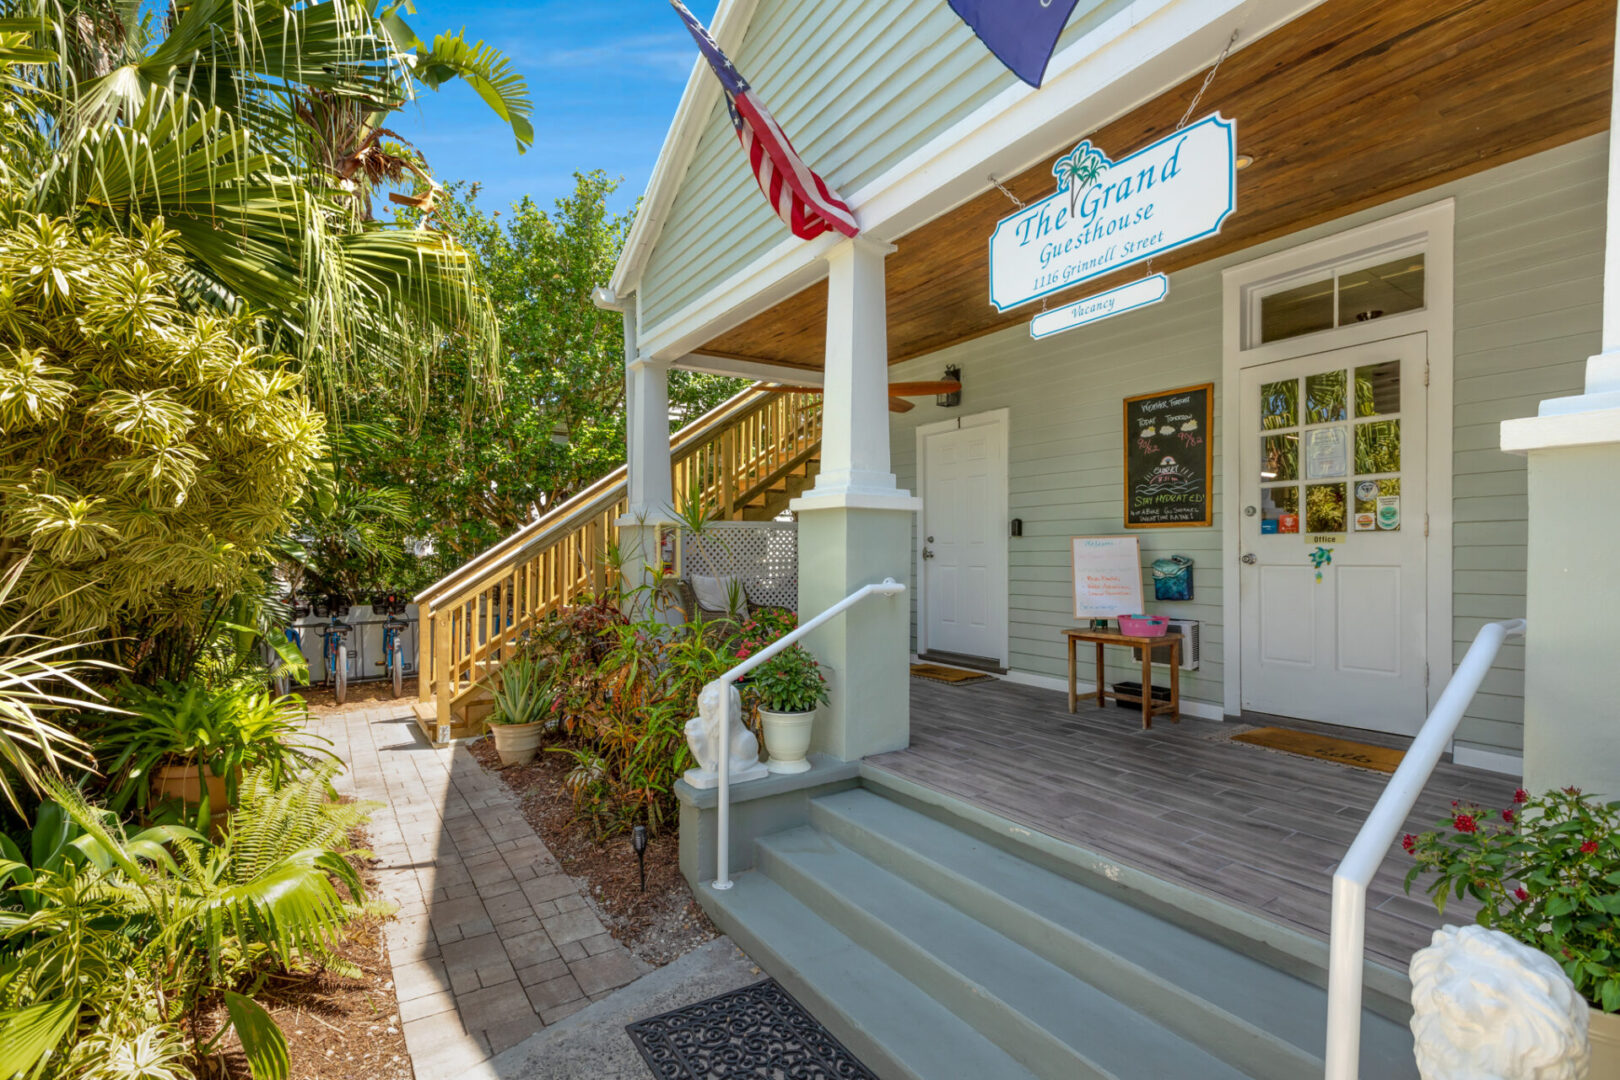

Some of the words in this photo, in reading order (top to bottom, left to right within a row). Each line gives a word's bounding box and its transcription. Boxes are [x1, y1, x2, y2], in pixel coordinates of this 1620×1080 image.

[1015, 202, 1068, 247] The
[1080, 135, 1189, 229] Grand
[1032, 272, 1059, 291] 1116
[1062, 246, 1115, 283] Grinnell
[1120, 230, 1164, 259] Street
[1039, 203, 1154, 270] Guesthouse
[1071, 297, 1115, 319] Vacancy
